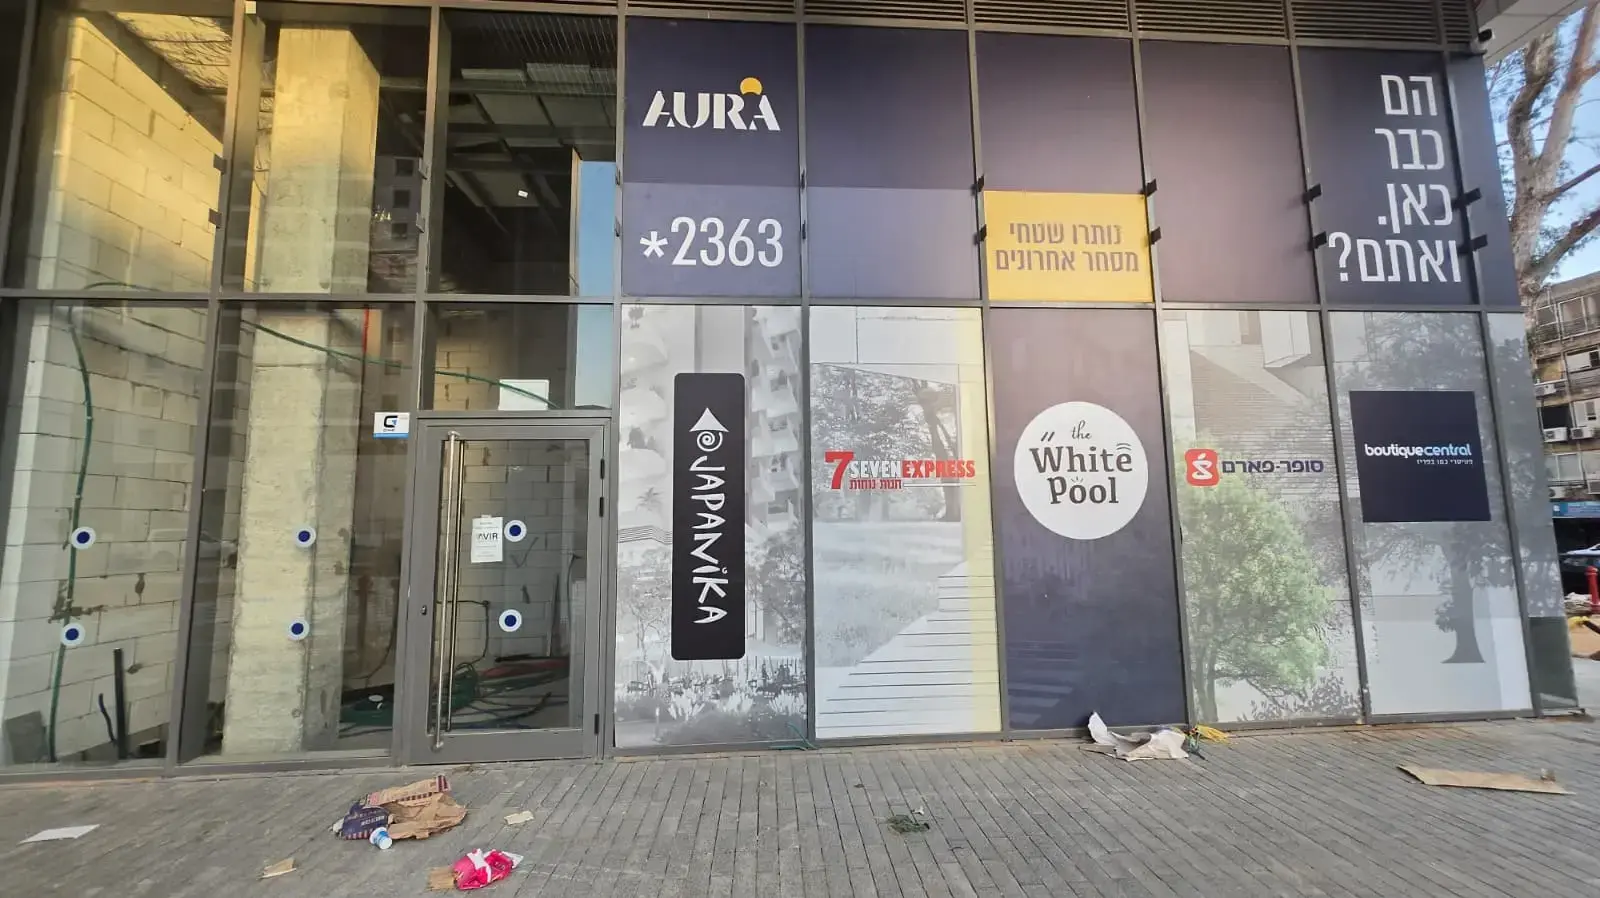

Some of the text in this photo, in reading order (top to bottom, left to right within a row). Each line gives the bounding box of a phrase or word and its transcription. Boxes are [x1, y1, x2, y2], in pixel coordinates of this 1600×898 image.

[1381, 74, 1438, 116] הם
[642, 90, 781, 131] AURA
[1375, 128, 1445, 170] כבר
[1378, 183, 1453, 234] כאן.
[1009, 222, 1122, 245] נותרו שטחי
[995, 249, 1139, 272] מסחר אחרונים
[1328, 232, 1462, 283] ואתם?
[1071, 420, 1092, 440] the
[1029, 446, 1133, 474] White
[1222, 460, 1324, 474] סופר-פארם
[1046, 476, 1119, 504] Pool
